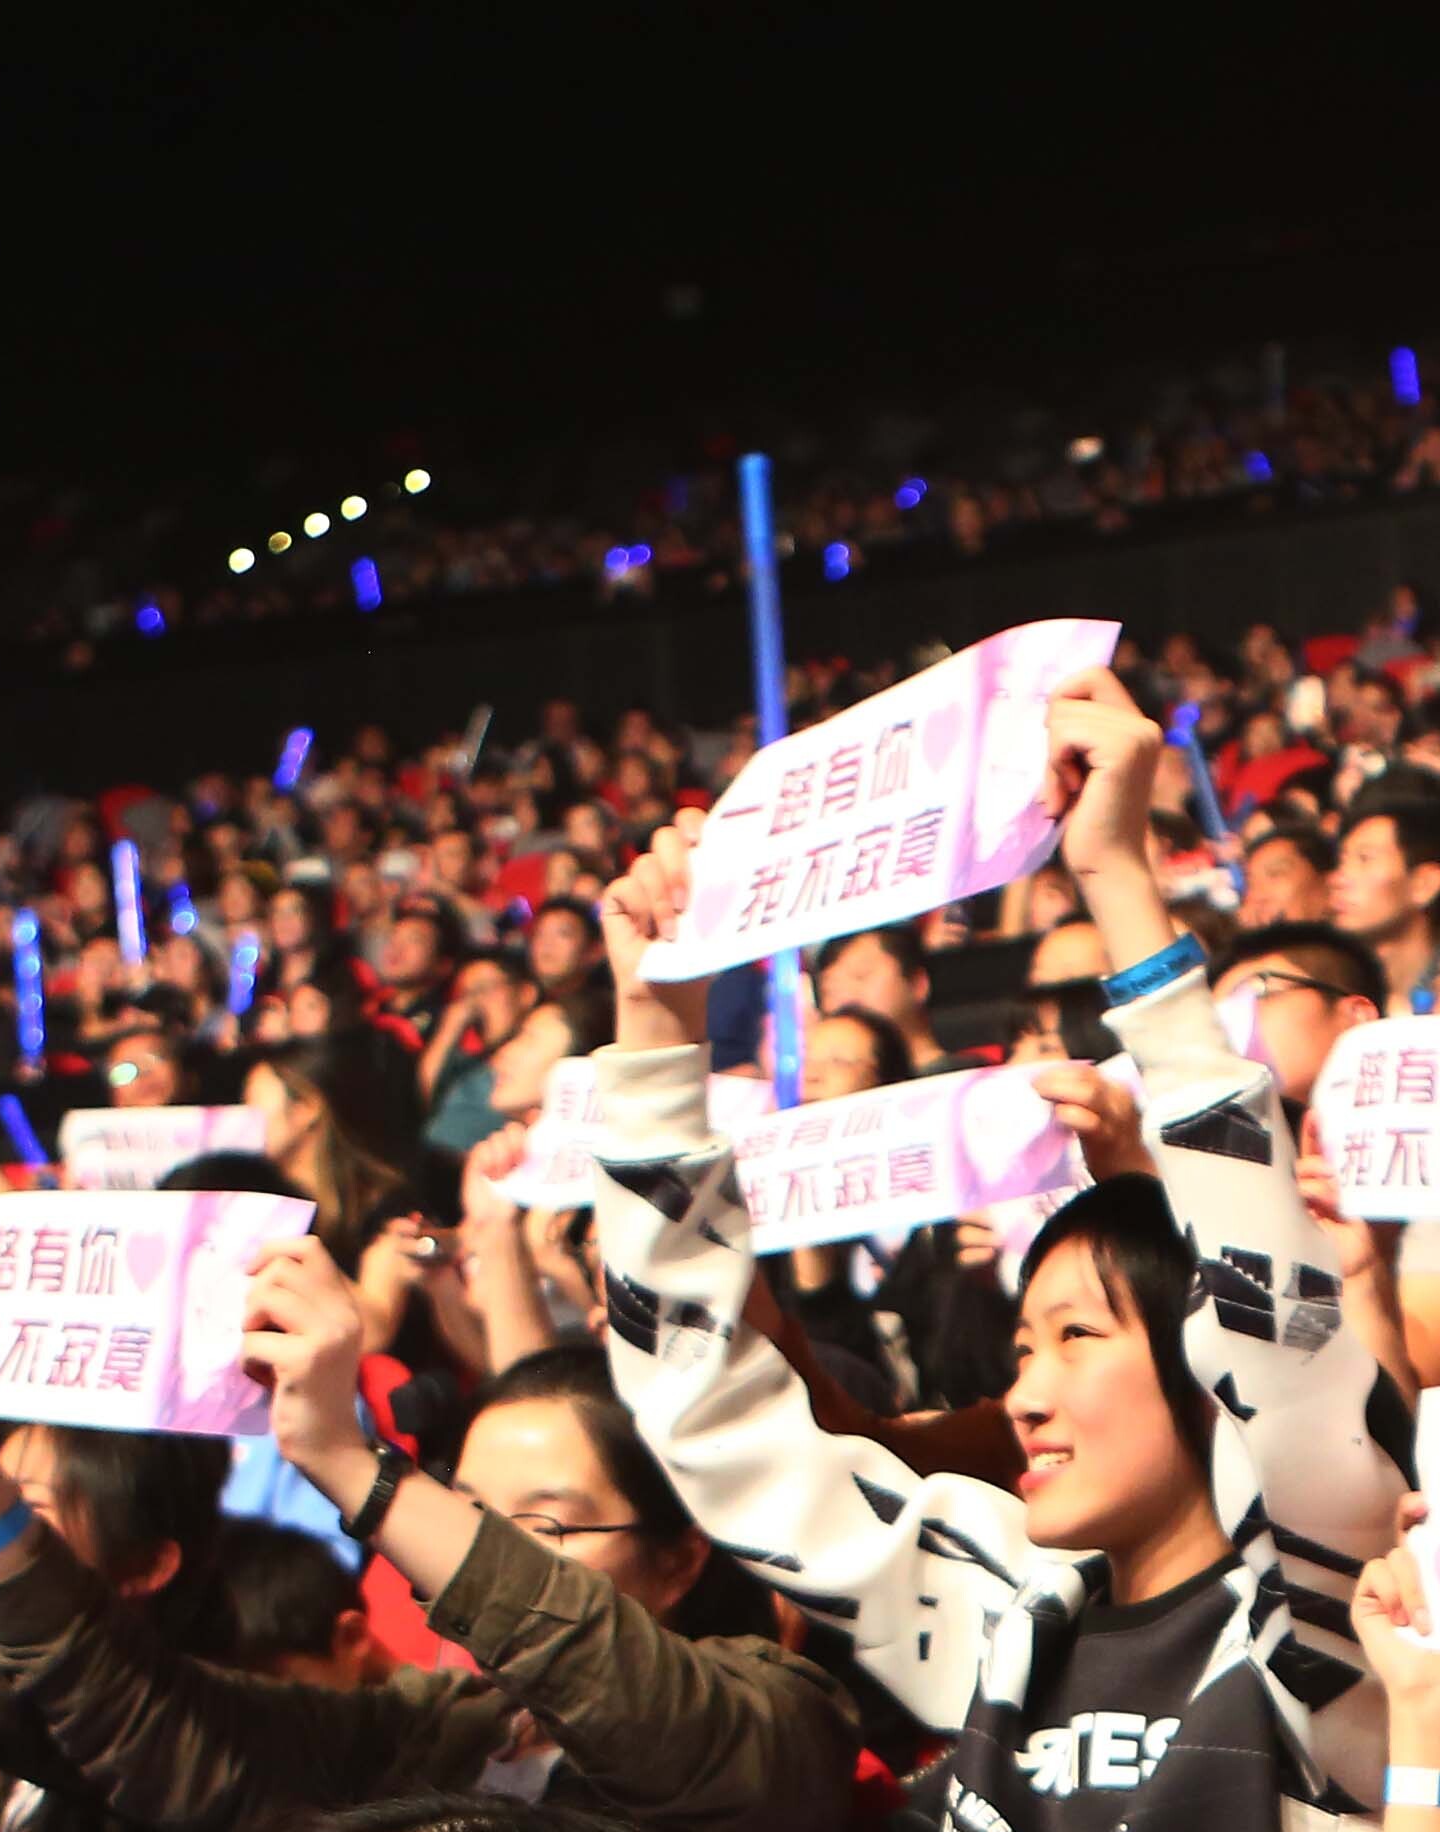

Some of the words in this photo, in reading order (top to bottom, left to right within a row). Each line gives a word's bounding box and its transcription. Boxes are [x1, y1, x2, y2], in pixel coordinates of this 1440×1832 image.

[720, 718, 916, 838] 一路有你
[737, 807, 947, 934] 我不寂寞
